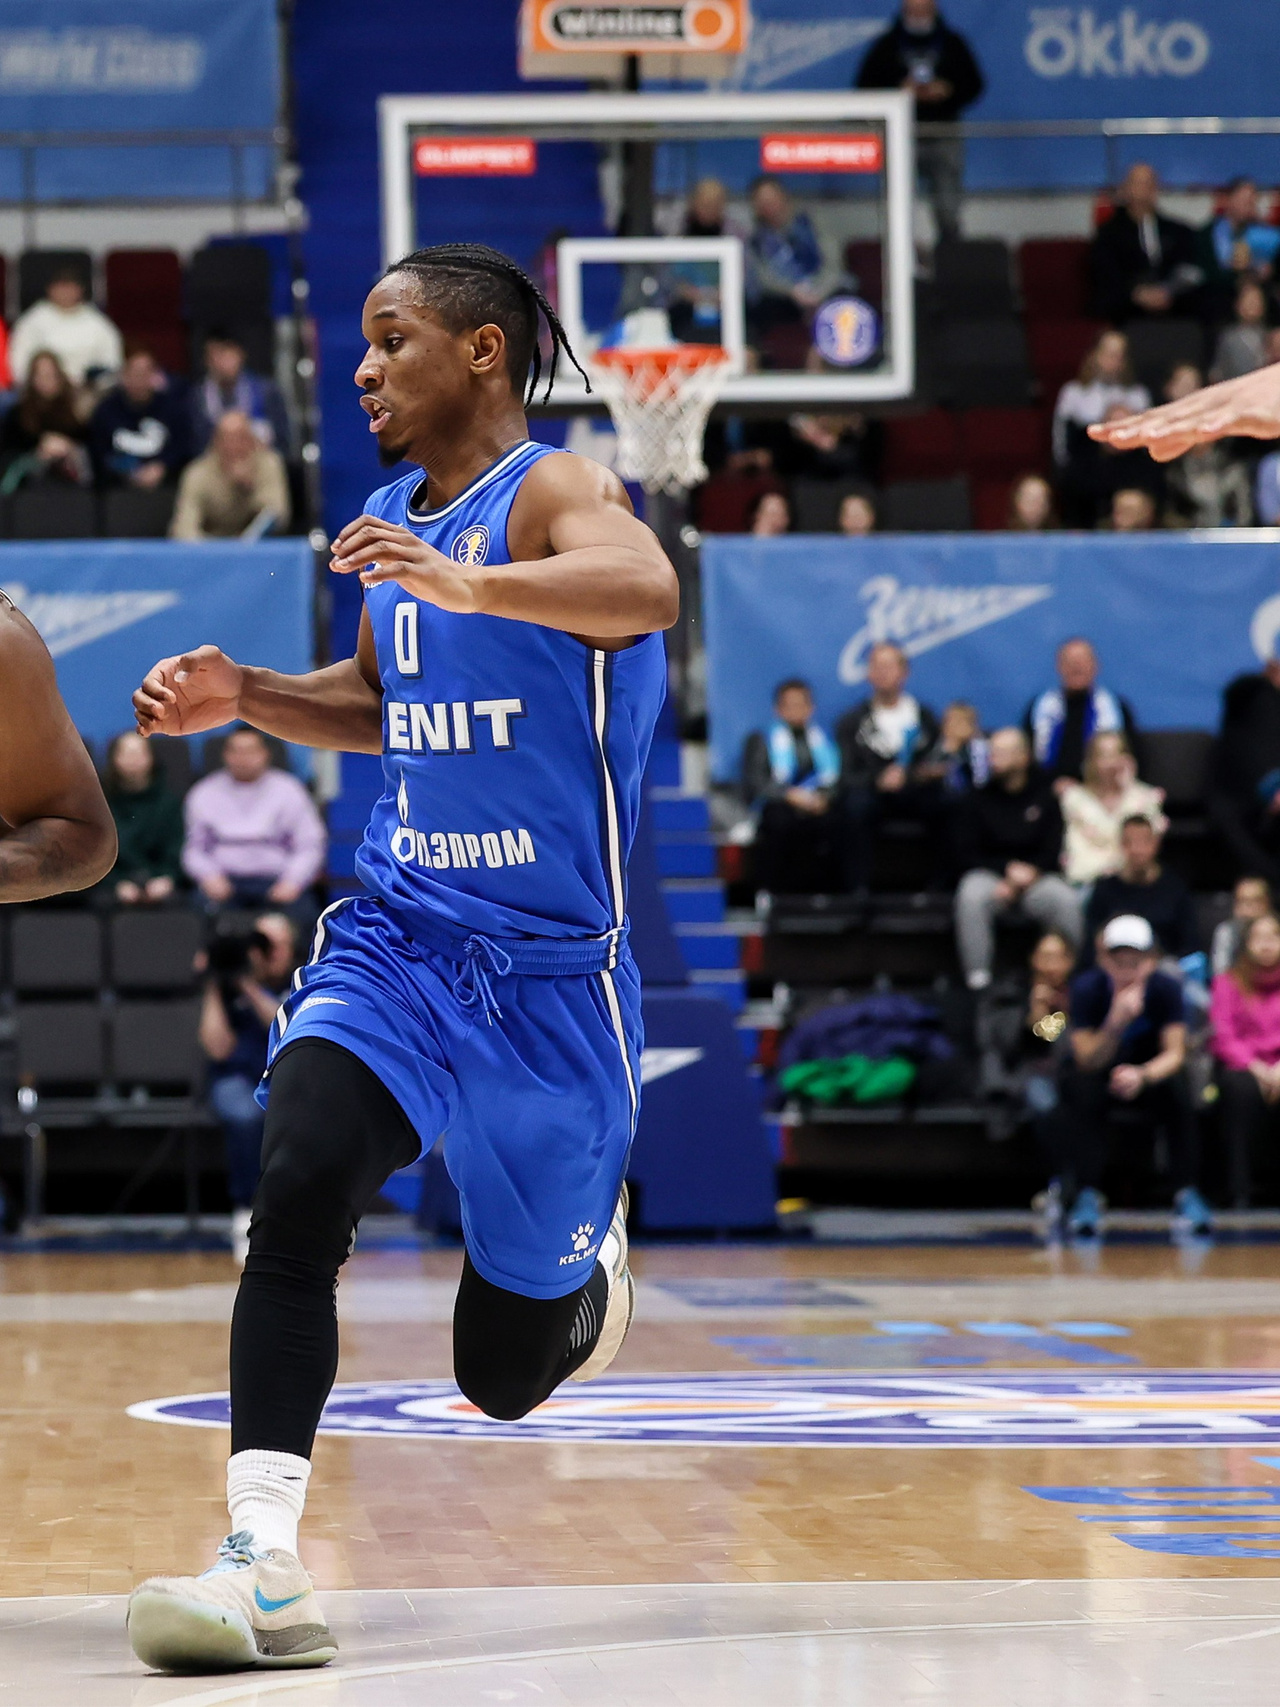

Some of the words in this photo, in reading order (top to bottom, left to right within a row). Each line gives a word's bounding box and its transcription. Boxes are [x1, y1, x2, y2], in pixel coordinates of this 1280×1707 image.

[394, 601, 421, 677] 0
[386, 698, 524, 752] ENIT
[559, 1244, 597, 1266] KELME
